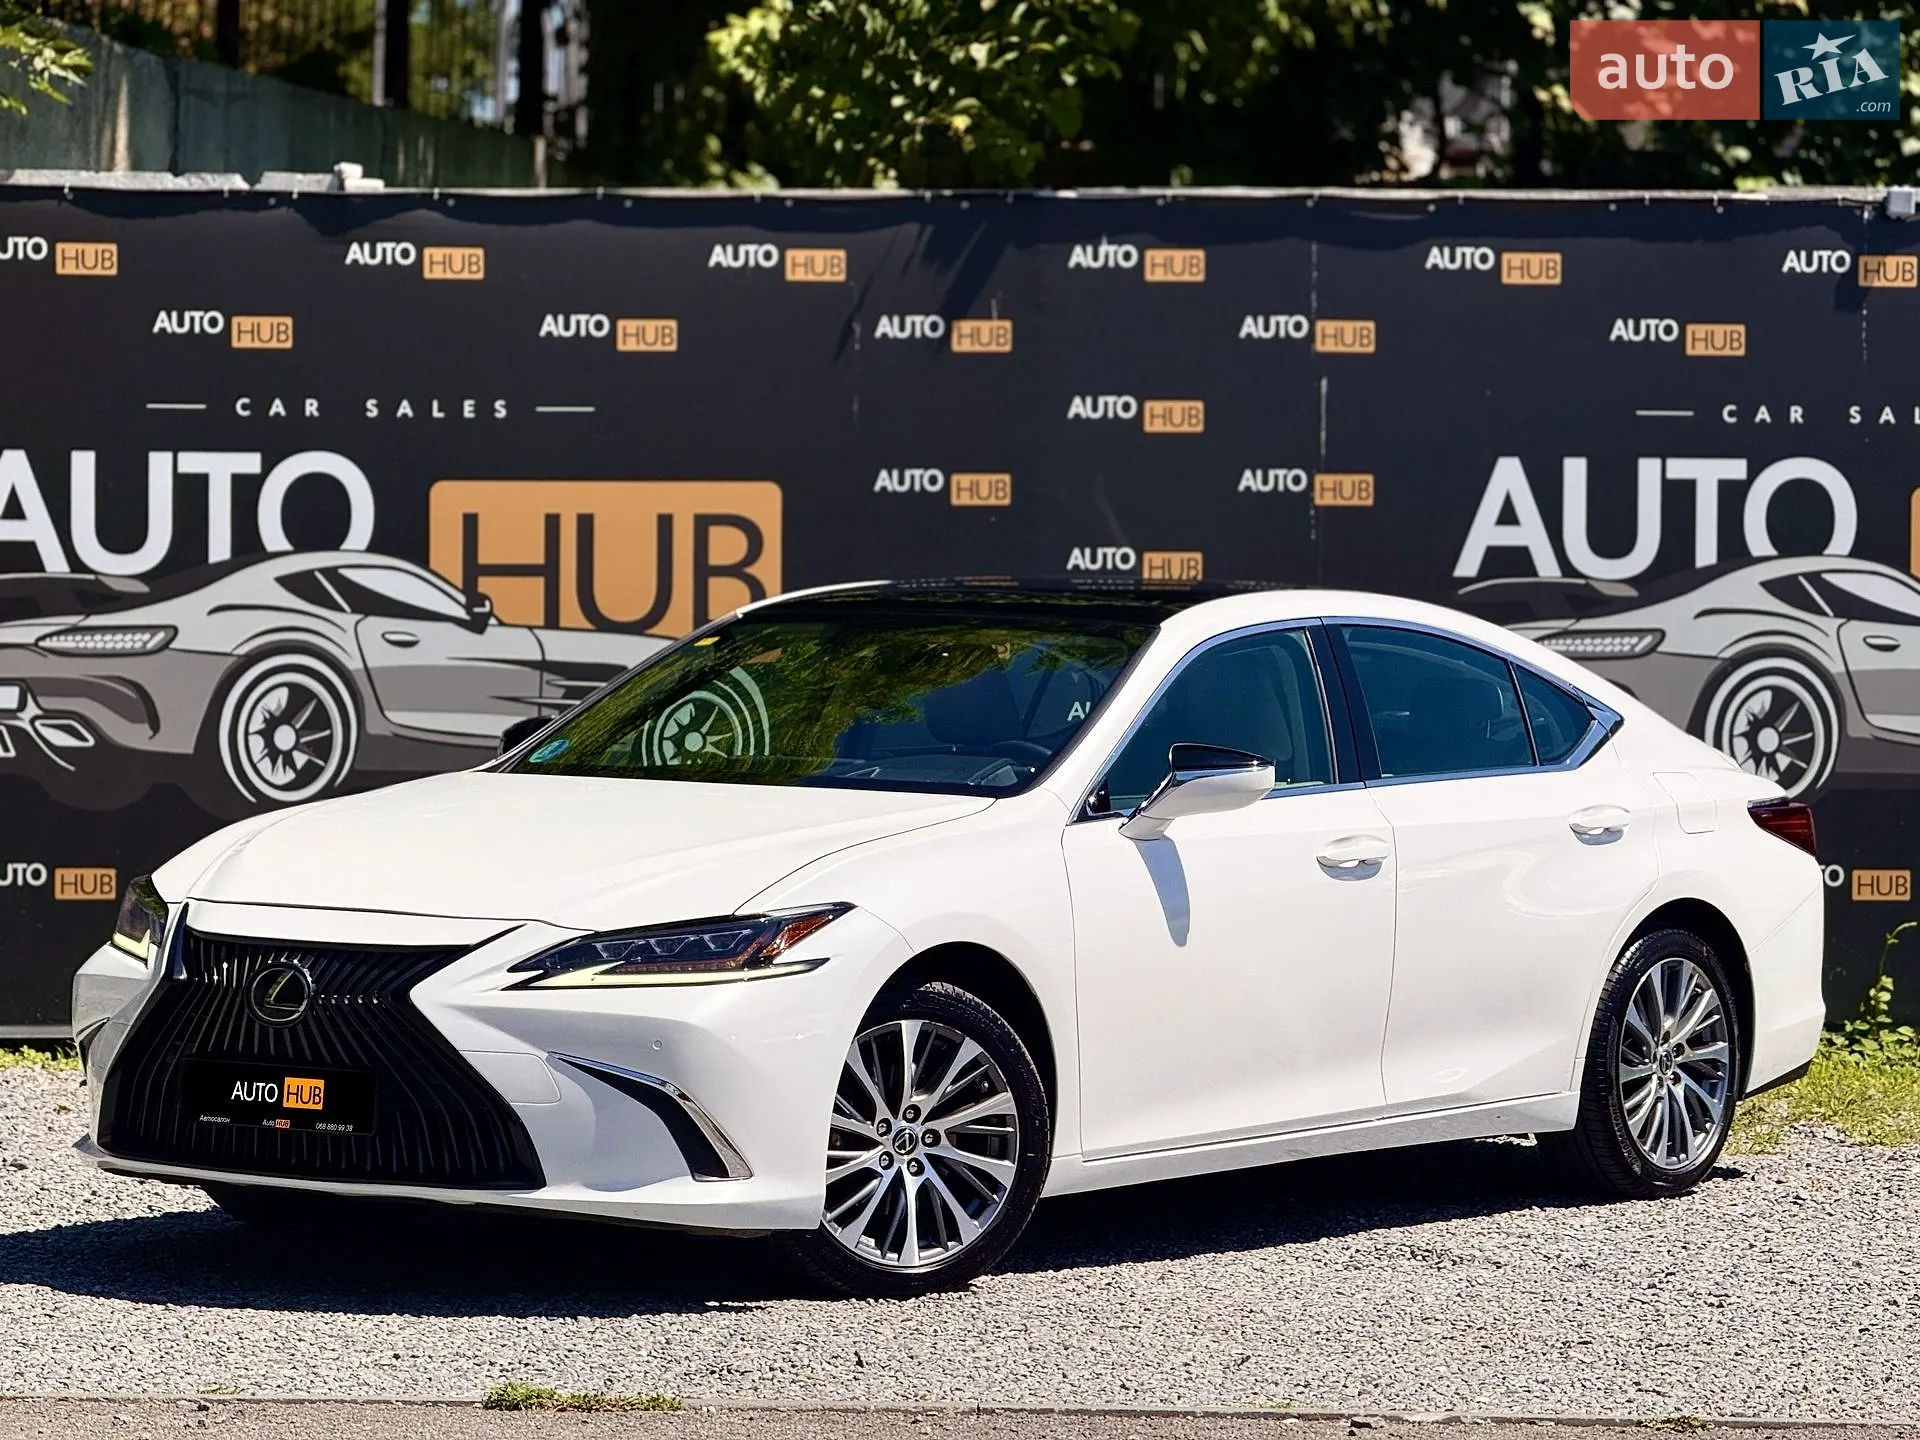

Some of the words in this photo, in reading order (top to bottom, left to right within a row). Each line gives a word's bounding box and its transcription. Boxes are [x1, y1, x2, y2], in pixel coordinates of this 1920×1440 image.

[0, 236, 48, 261] UTO
[61, 248, 114, 272] HUB
[345, 242, 416, 266] AUTO
[429, 253, 481, 275] HUB
[709, 244, 779, 268] AUTO
[790, 255, 844, 277] HUB
[1069, 244, 1138, 269] AUTO
[1149, 255, 1203, 277] HUB
[1425, 246, 1495, 270] AUTO
[1507, 258, 1558, 280] HUB
[1782, 250, 1851, 274] AUTO
[1864, 261, 1914, 282] HUB
[153, 310, 224, 335] AUTO
[237, 321, 291, 344] HUB
[540, 314, 610, 338] AUTO
[623, 325, 675, 347] HUB
[875, 314, 944, 339] AUTO
[957, 325, 1011, 348] HUB
[1239, 314, 1308, 339] AUTO
[1320, 326, 1372, 348] HUB
[1610, 318, 1678, 342] AUTO
[1692, 330, 1742, 352] HUB
[235, 398, 320, 417] CAR
[366, 398, 508, 418] SALES
[1068, 395, 1137, 419] AUTO
[1149, 407, 1202, 428] HUB
[1722, 404, 1805, 424] CAR
[874, 468, 944, 493] AUTO
[956, 479, 1008, 501] HUB
[1238, 469, 1307, 492] AUTO
[1319, 479, 1371, 501] HUB
[1452, 456, 1857, 582] AUTO
[0, 449, 375, 576] AUTO
[463, 512, 764, 634] HUB
[1067, 546, 1136, 571] AUTO
[1149, 558, 1201, 580] HUB
[0, 863, 47, 887] UTO
[61, 874, 113, 896] HUB
[1857, 875, 1908, 897] HUB
[231, 1080, 279, 1103] AUTO
[286, 1084, 323, 1106] HUB
[262, 1119, 275, 1127] Auto
